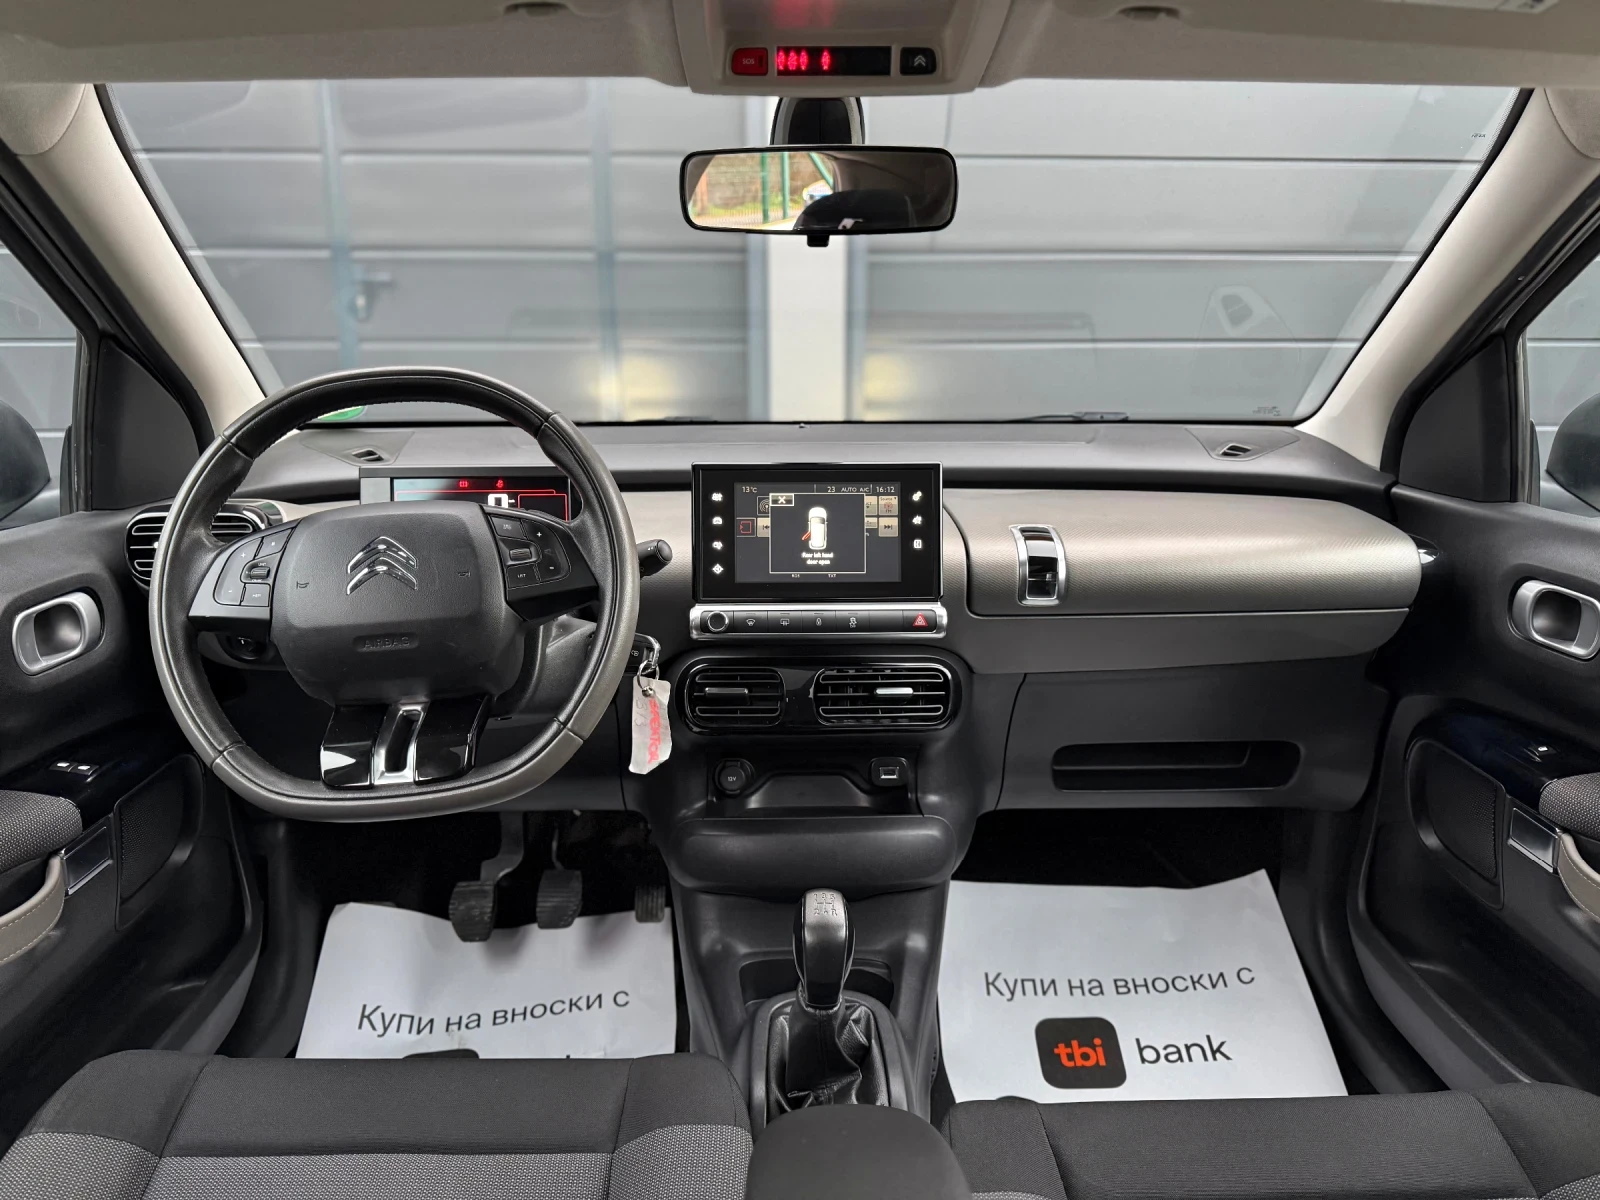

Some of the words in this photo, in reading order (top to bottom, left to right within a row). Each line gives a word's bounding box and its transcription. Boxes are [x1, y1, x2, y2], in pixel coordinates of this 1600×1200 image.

[363, 636, 410, 650] AIRBAG
[984, 972, 1058, 1001] Купи
[1068, 978, 1105, 997] на
[1113, 971, 1228, 996] вноски
[1236, 967, 1256, 986] с
[357, 1003, 434, 1038] Купи
[445, 1010, 481, 1033] на
[492, 994, 603, 1026] вноски
[613, 991, 630, 1009] с
[1053, 1038, 1107, 1068] tbi
[1135, 1035, 1233, 1064] bank
